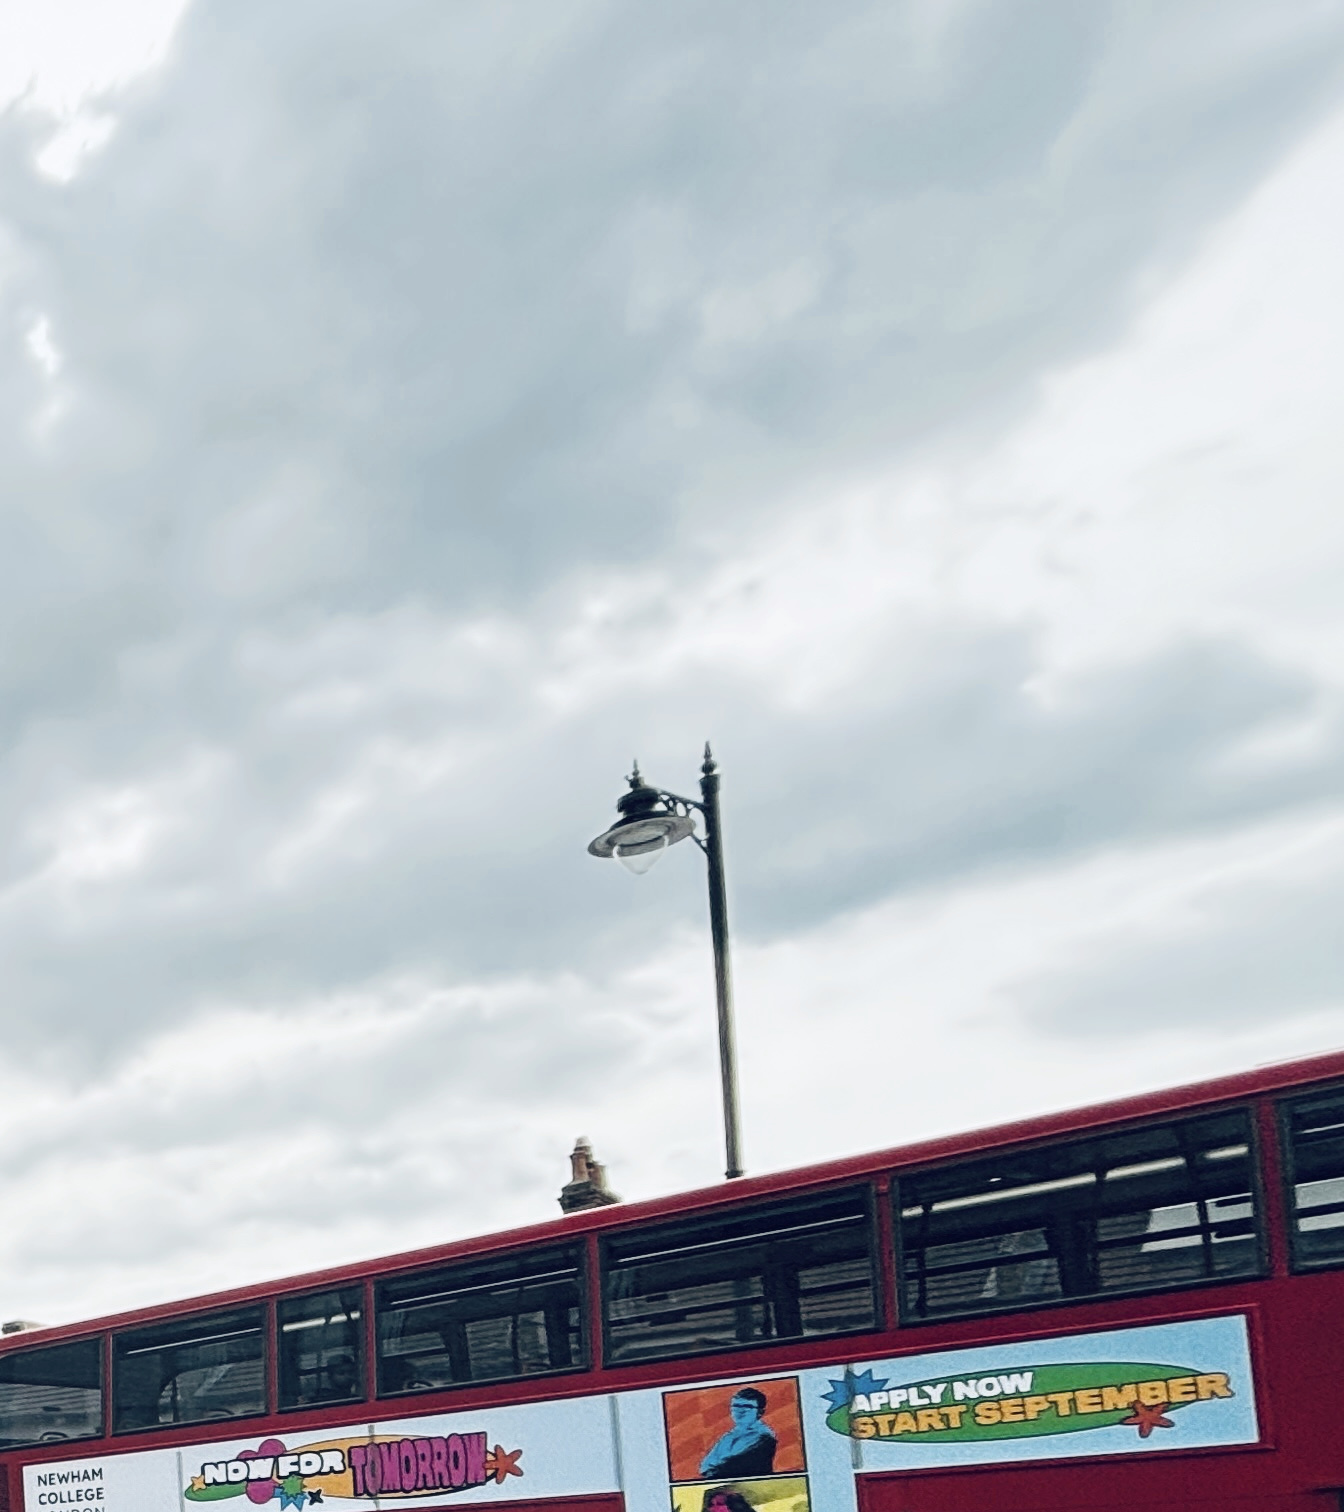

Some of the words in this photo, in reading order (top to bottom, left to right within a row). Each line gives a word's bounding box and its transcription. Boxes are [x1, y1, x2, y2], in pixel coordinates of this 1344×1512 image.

[850, 1382, 949, 1413] APPLY
[953, 1371, 1034, 1401] NOW
[850, 1404, 967, 1439] START
[973, 1373, 1234, 1425] SEPTEMBER
[37, 1467, 104, 1487] NEWHAM
[202, 1454, 277, 1485] NOW
[275, 1449, 346, 1479] FOR
[347, 1431, 488, 1498] TOMORROW
[38, 1487, 105, 1506] COLLEGE
